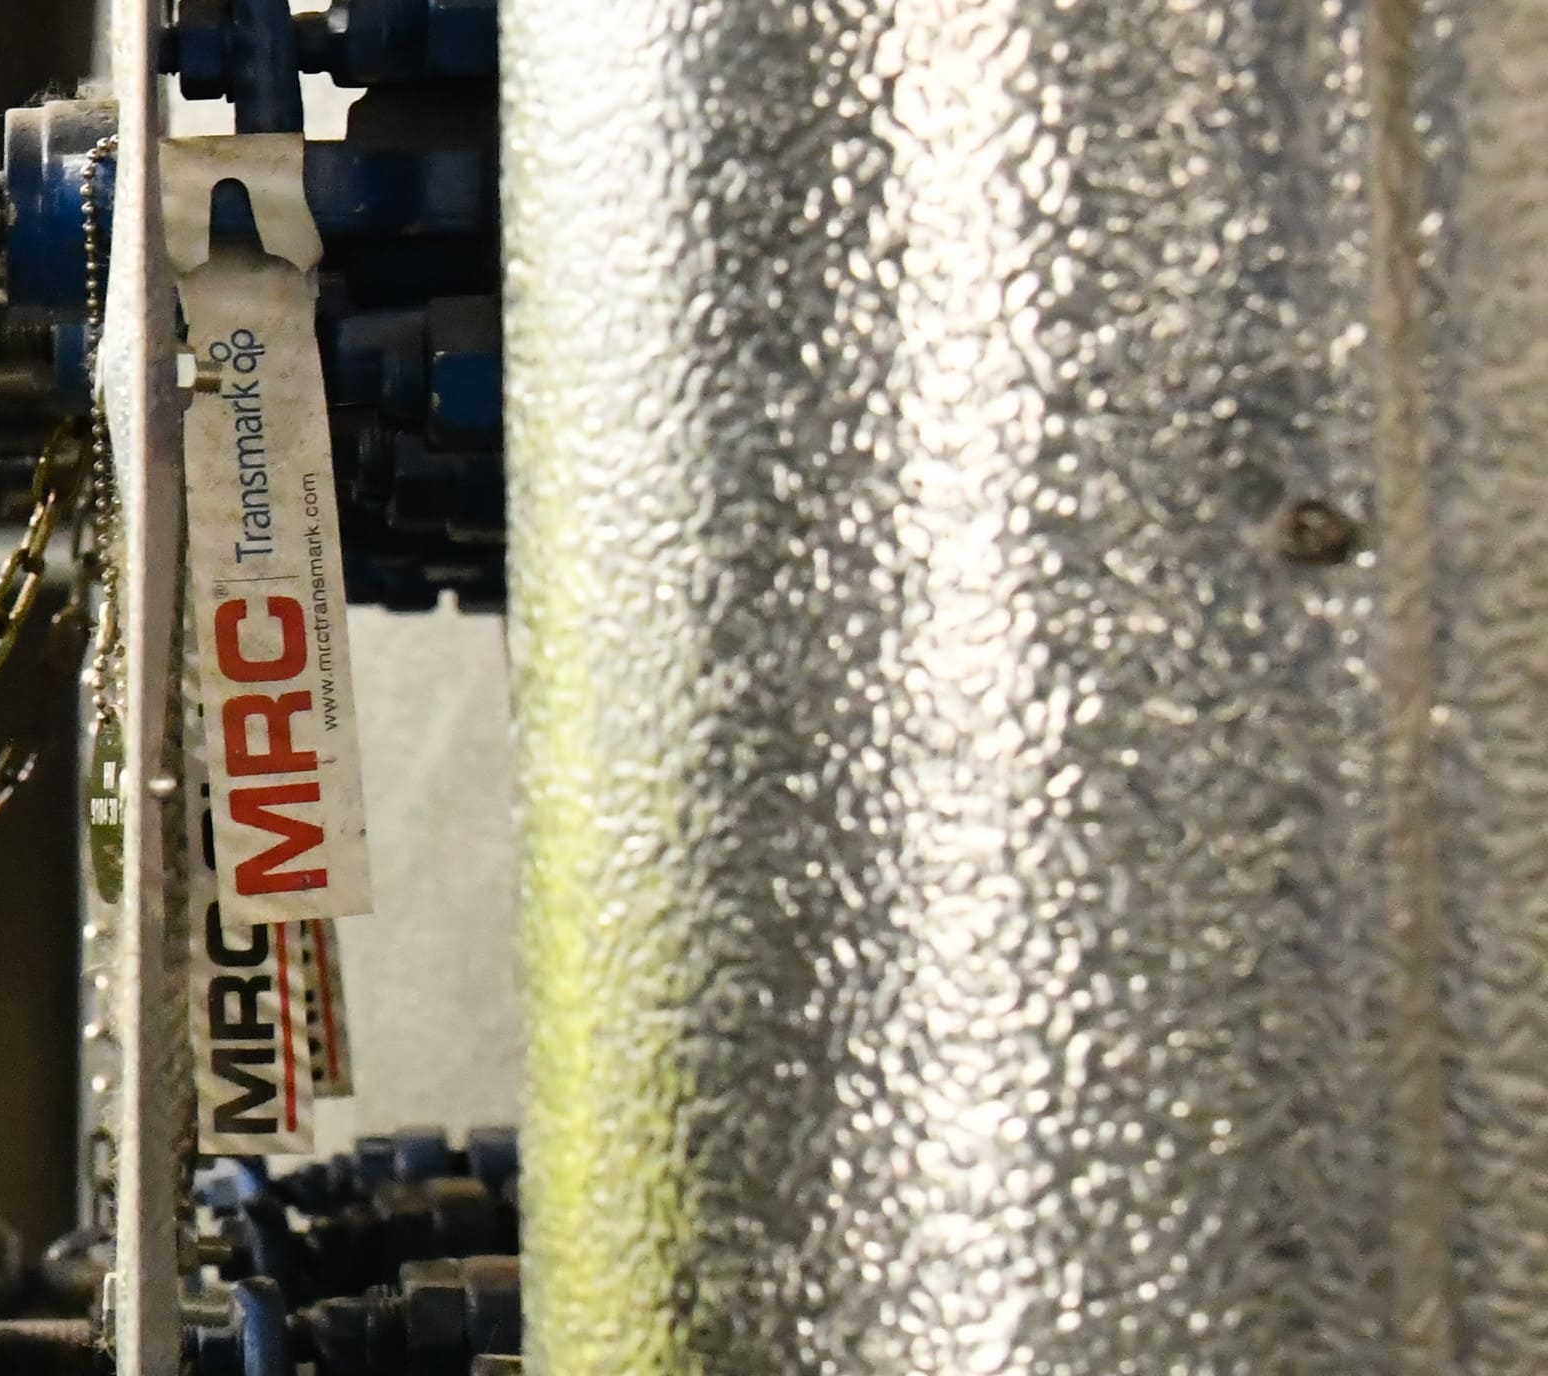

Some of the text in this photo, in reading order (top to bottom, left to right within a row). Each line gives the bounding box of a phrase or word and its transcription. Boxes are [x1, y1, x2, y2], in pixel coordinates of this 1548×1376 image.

[214, 380, 330, 897] MRC Transmark
[302, 472, 338, 733] www.mrctransmark.com
[206, 900, 279, 1135] MRC
